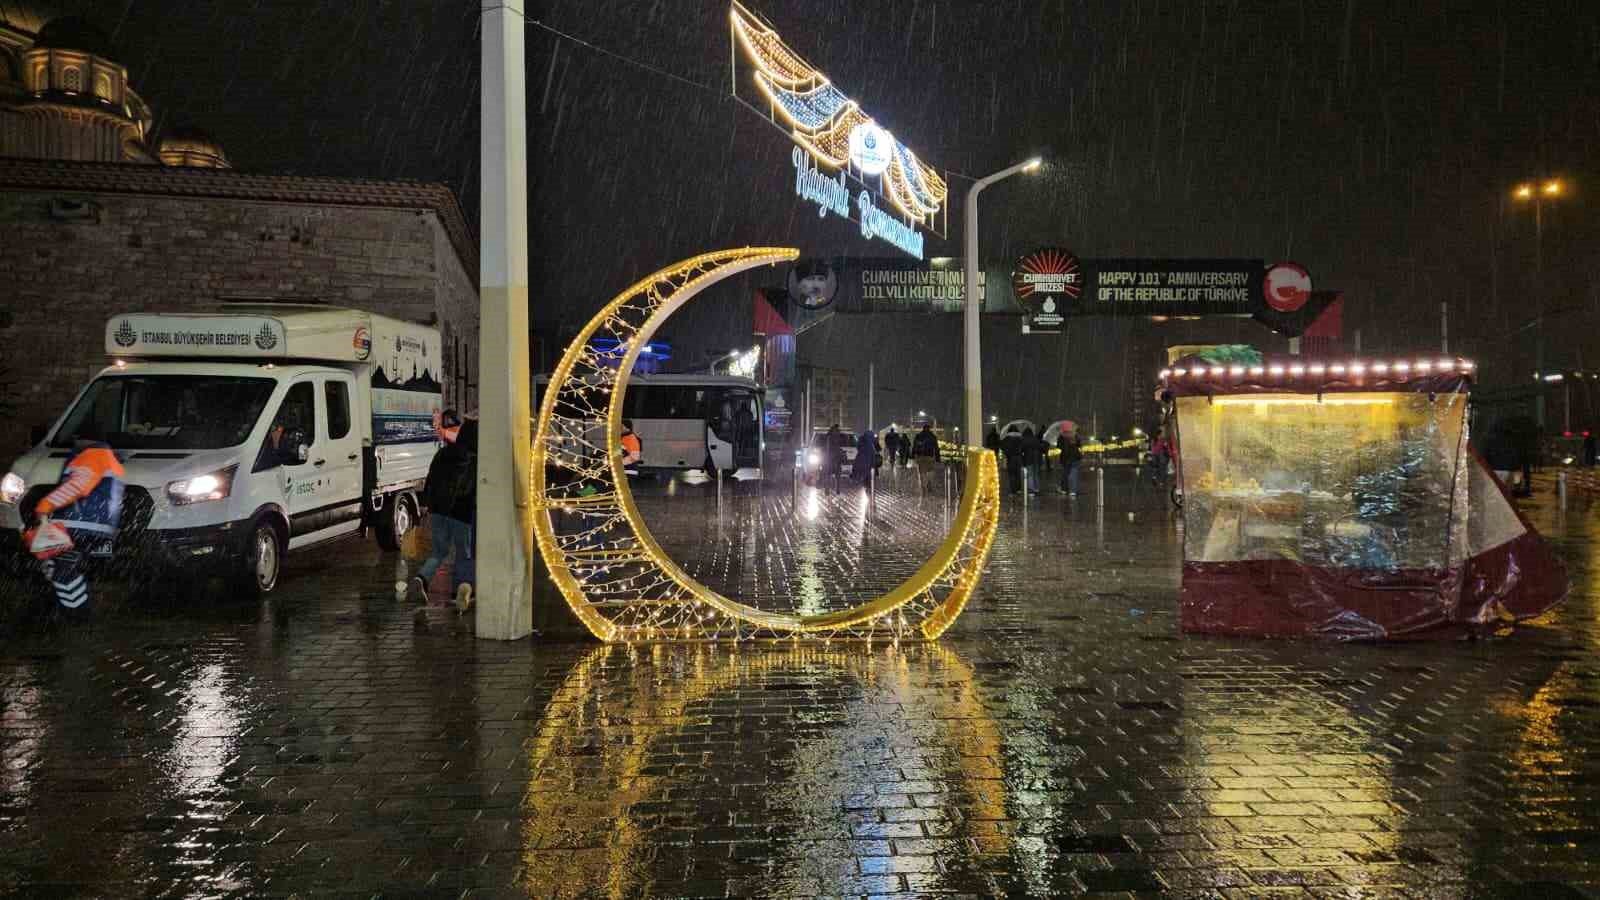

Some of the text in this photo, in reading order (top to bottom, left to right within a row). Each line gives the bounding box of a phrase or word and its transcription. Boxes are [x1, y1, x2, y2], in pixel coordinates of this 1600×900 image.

[862, 268, 986, 286] CUMHURİYETİMİN
[1098, 272, 1137, 285] HAPPY
[1167, 272, 1249, 285] ANNIVERSARY
[862, 285, 883, 299] 101
[909, 285, 945, 300] KUTLU
[946, 285, 985, 300] OLSN
[1098, 287, 1112, 301] OF
[1113, 287, 1134, 301] THE
[1135, 287, 1187, 301] REPUBLIC
[1187, 287, 1203, 301] OF
